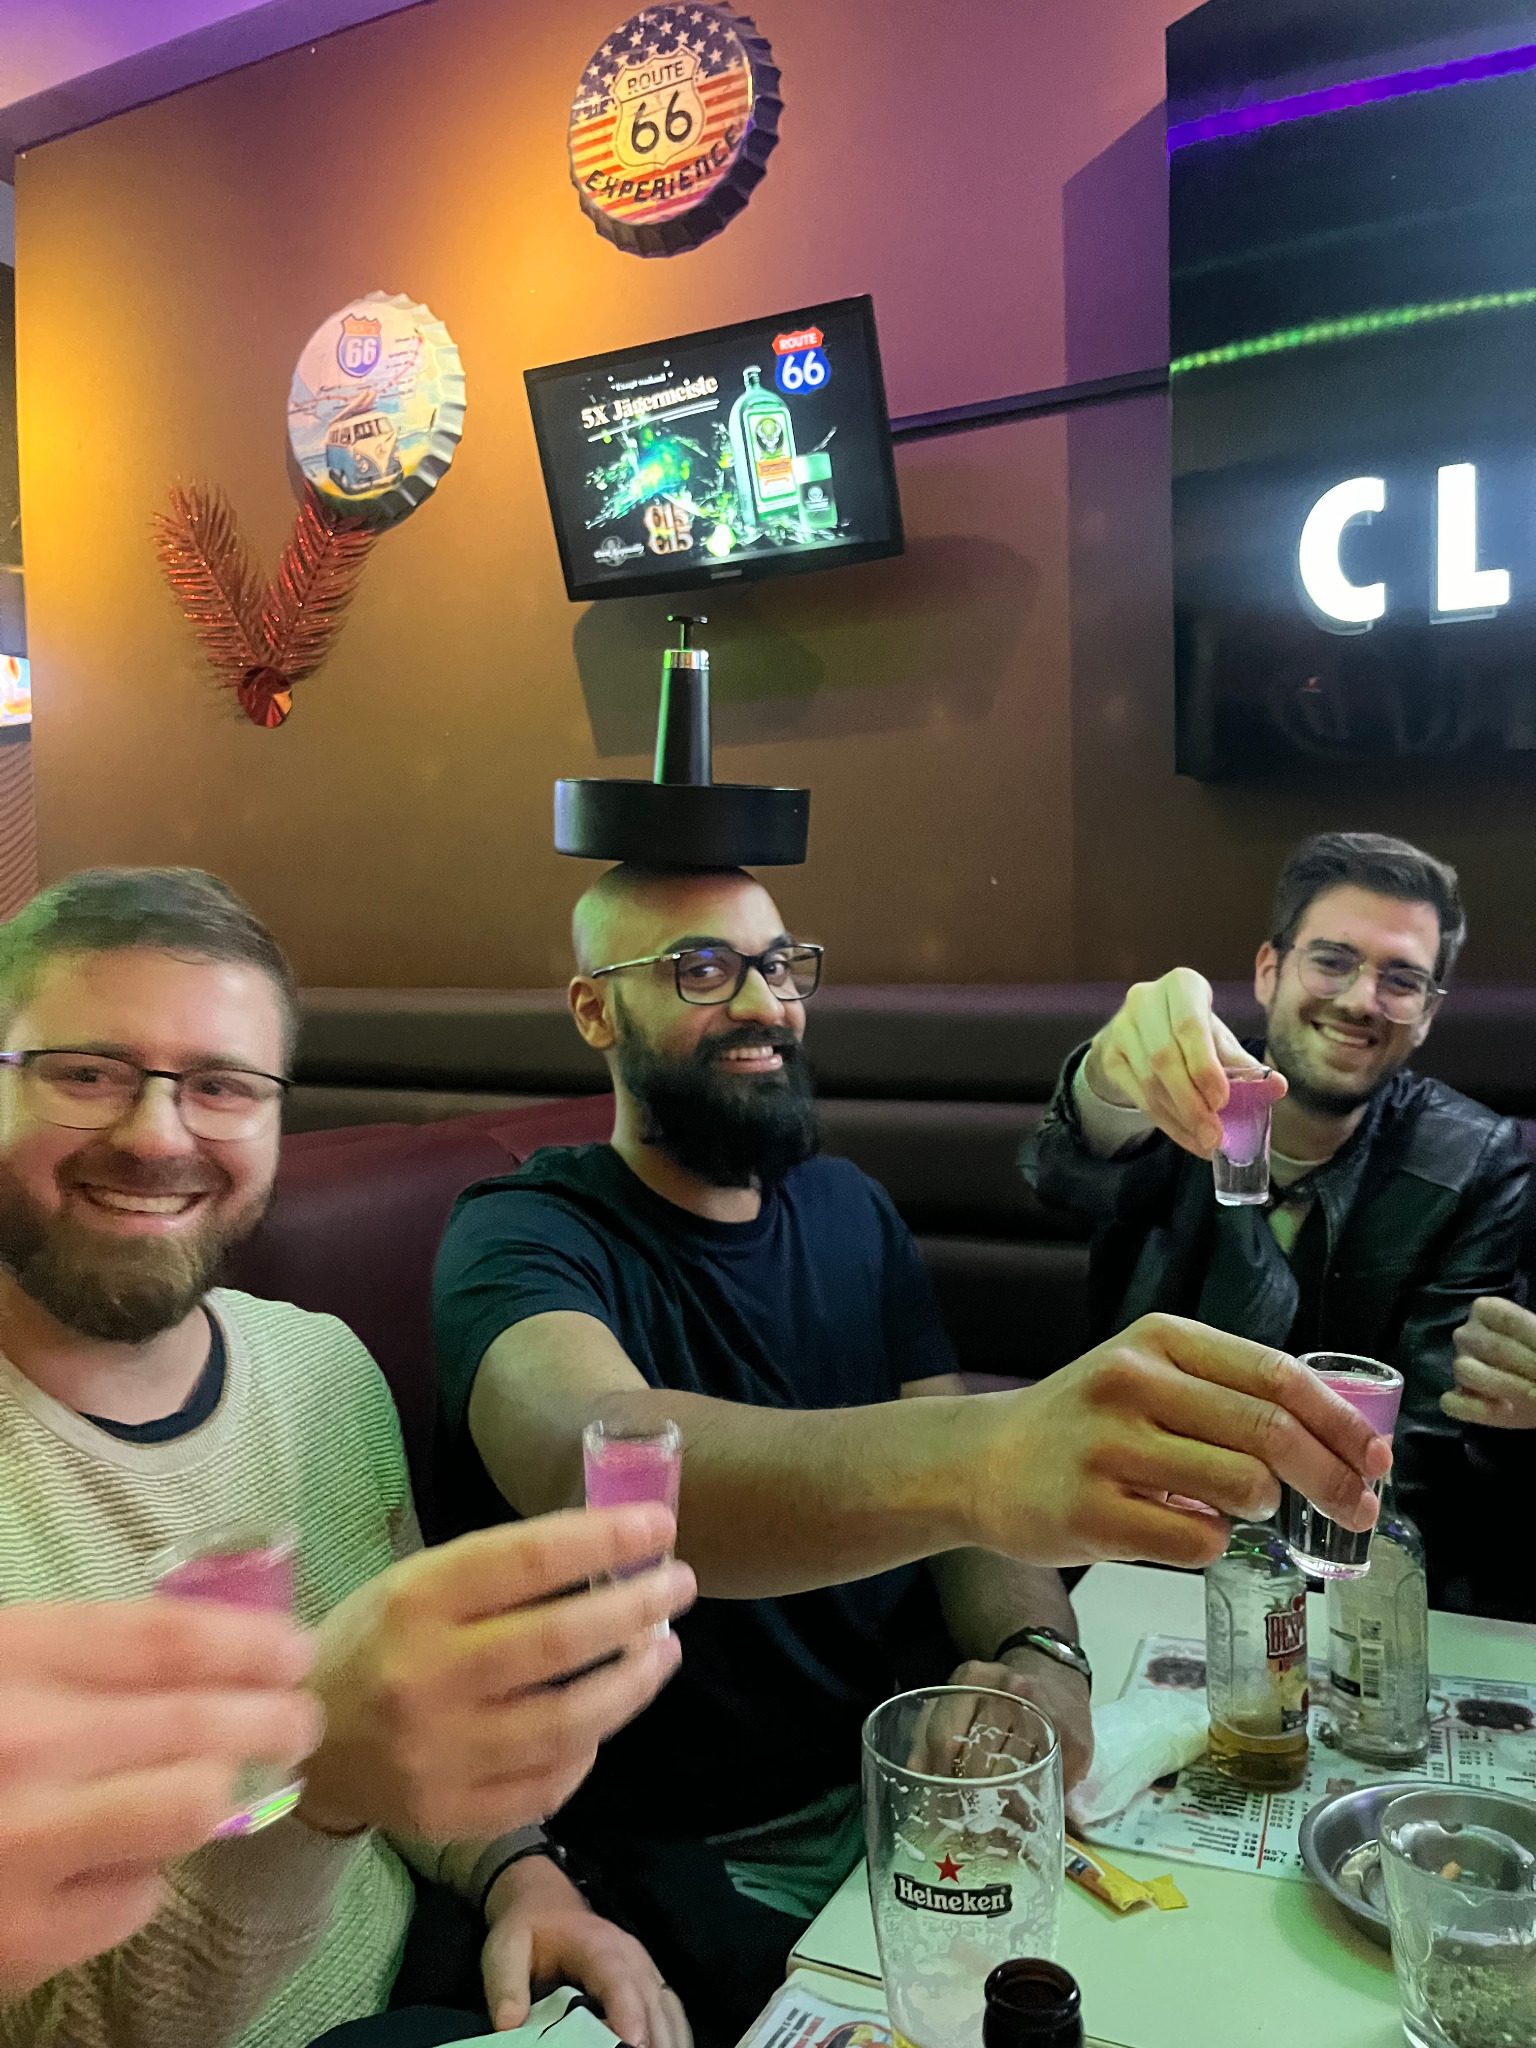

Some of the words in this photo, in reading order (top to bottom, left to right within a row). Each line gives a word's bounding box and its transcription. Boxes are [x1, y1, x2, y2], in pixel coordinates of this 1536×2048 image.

[627, 60, 685, 95] ROUTE
[631, 90, 692, 154] 66
[585, 119, 746, 203] EXPERIENCE
[346, 338, 378, 368] 66
[779, 332, 818, 350] ROUTE
[782, 350, 825, 390] 66
[899, 1877, 1006, 1912] Heineken
